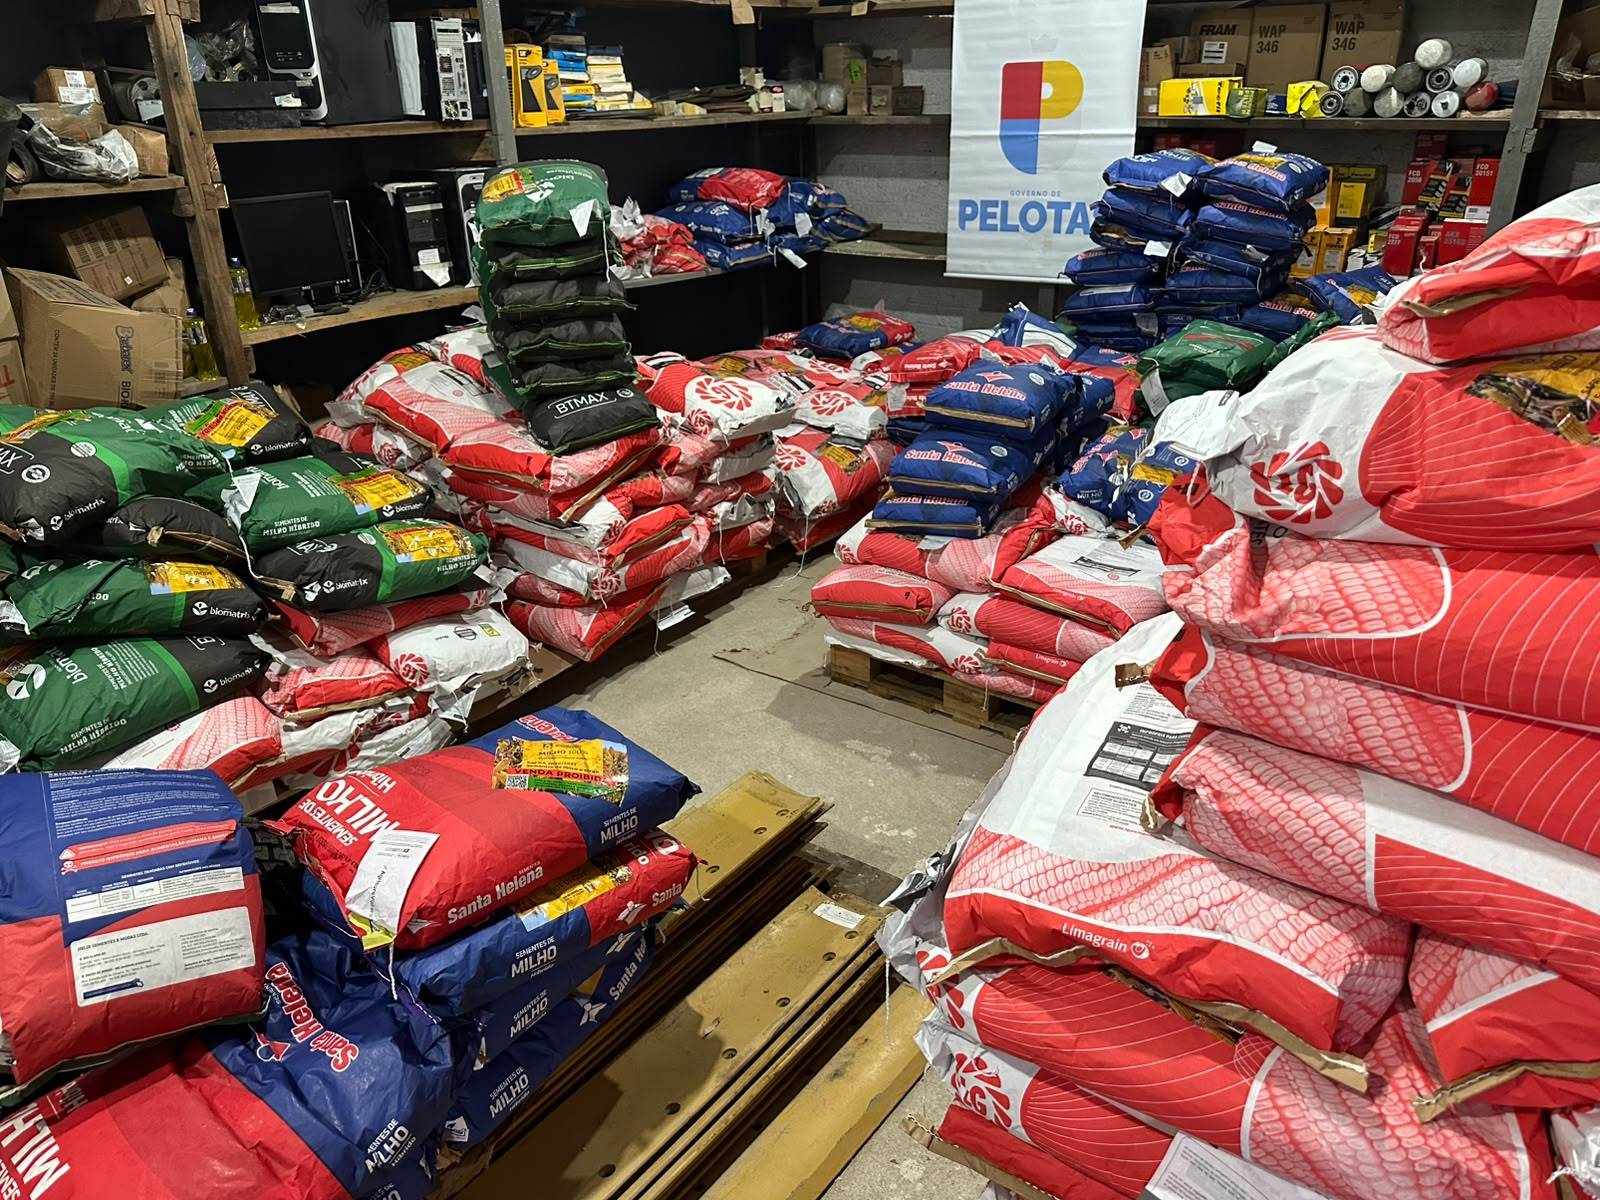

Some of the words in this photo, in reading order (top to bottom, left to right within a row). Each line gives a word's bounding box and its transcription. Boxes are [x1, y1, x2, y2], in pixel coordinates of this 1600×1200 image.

[1200, 24, 1238, 36] FRAM
[1259, 24, 1287, 39] WAP
[1335, 20, 1365, 35] WAP
[1256, 41, 1279, 54] 346
[1332, 37, 1356, 51] 346
[958, 199, 1091, 235] PELOTA
[555, 391, 609, 415] BTMAX
[980, 383, 1026, 401] Helena
[903, 449, 942, 460] Santa
[298, 798, 315, 812] DE
[313, 773, 400, 842] MILHO
[603, 811, 630, 827] SEMENTES
[311, 804, 357, 845] SEMENTES
[600, 815, 639, 844] MILHO
[448, 891, 492, 925] Santa
[495, 862, 545, 899] Helena
[652, 882, 682, 907] Santa
[515, 940, 546, 960] SEMENTES
[546, 936, 555, 947] DE
[1062, 921, 1128, 953] Limagrain
[511, 944, 558, 979] MILHO
[609, 958, 637, 1001] Santa
[265, 961, 325, 1044] Helena
[510, 996, 549, 1038] MILHO
[513, 996, 539, 1022] SEMENTES
[538, 990, 548, 1000] DE
[310, 1030, 360, 1073] Santa
[489, 1074, 517, 1100] SEMENTES
[516, 1065, 525, 1077] DE
[489, 1073, 530, 1119] MILHO
[389, 1118, 399, 1131] DE
[0, 1102, 71, 1200] MILH
